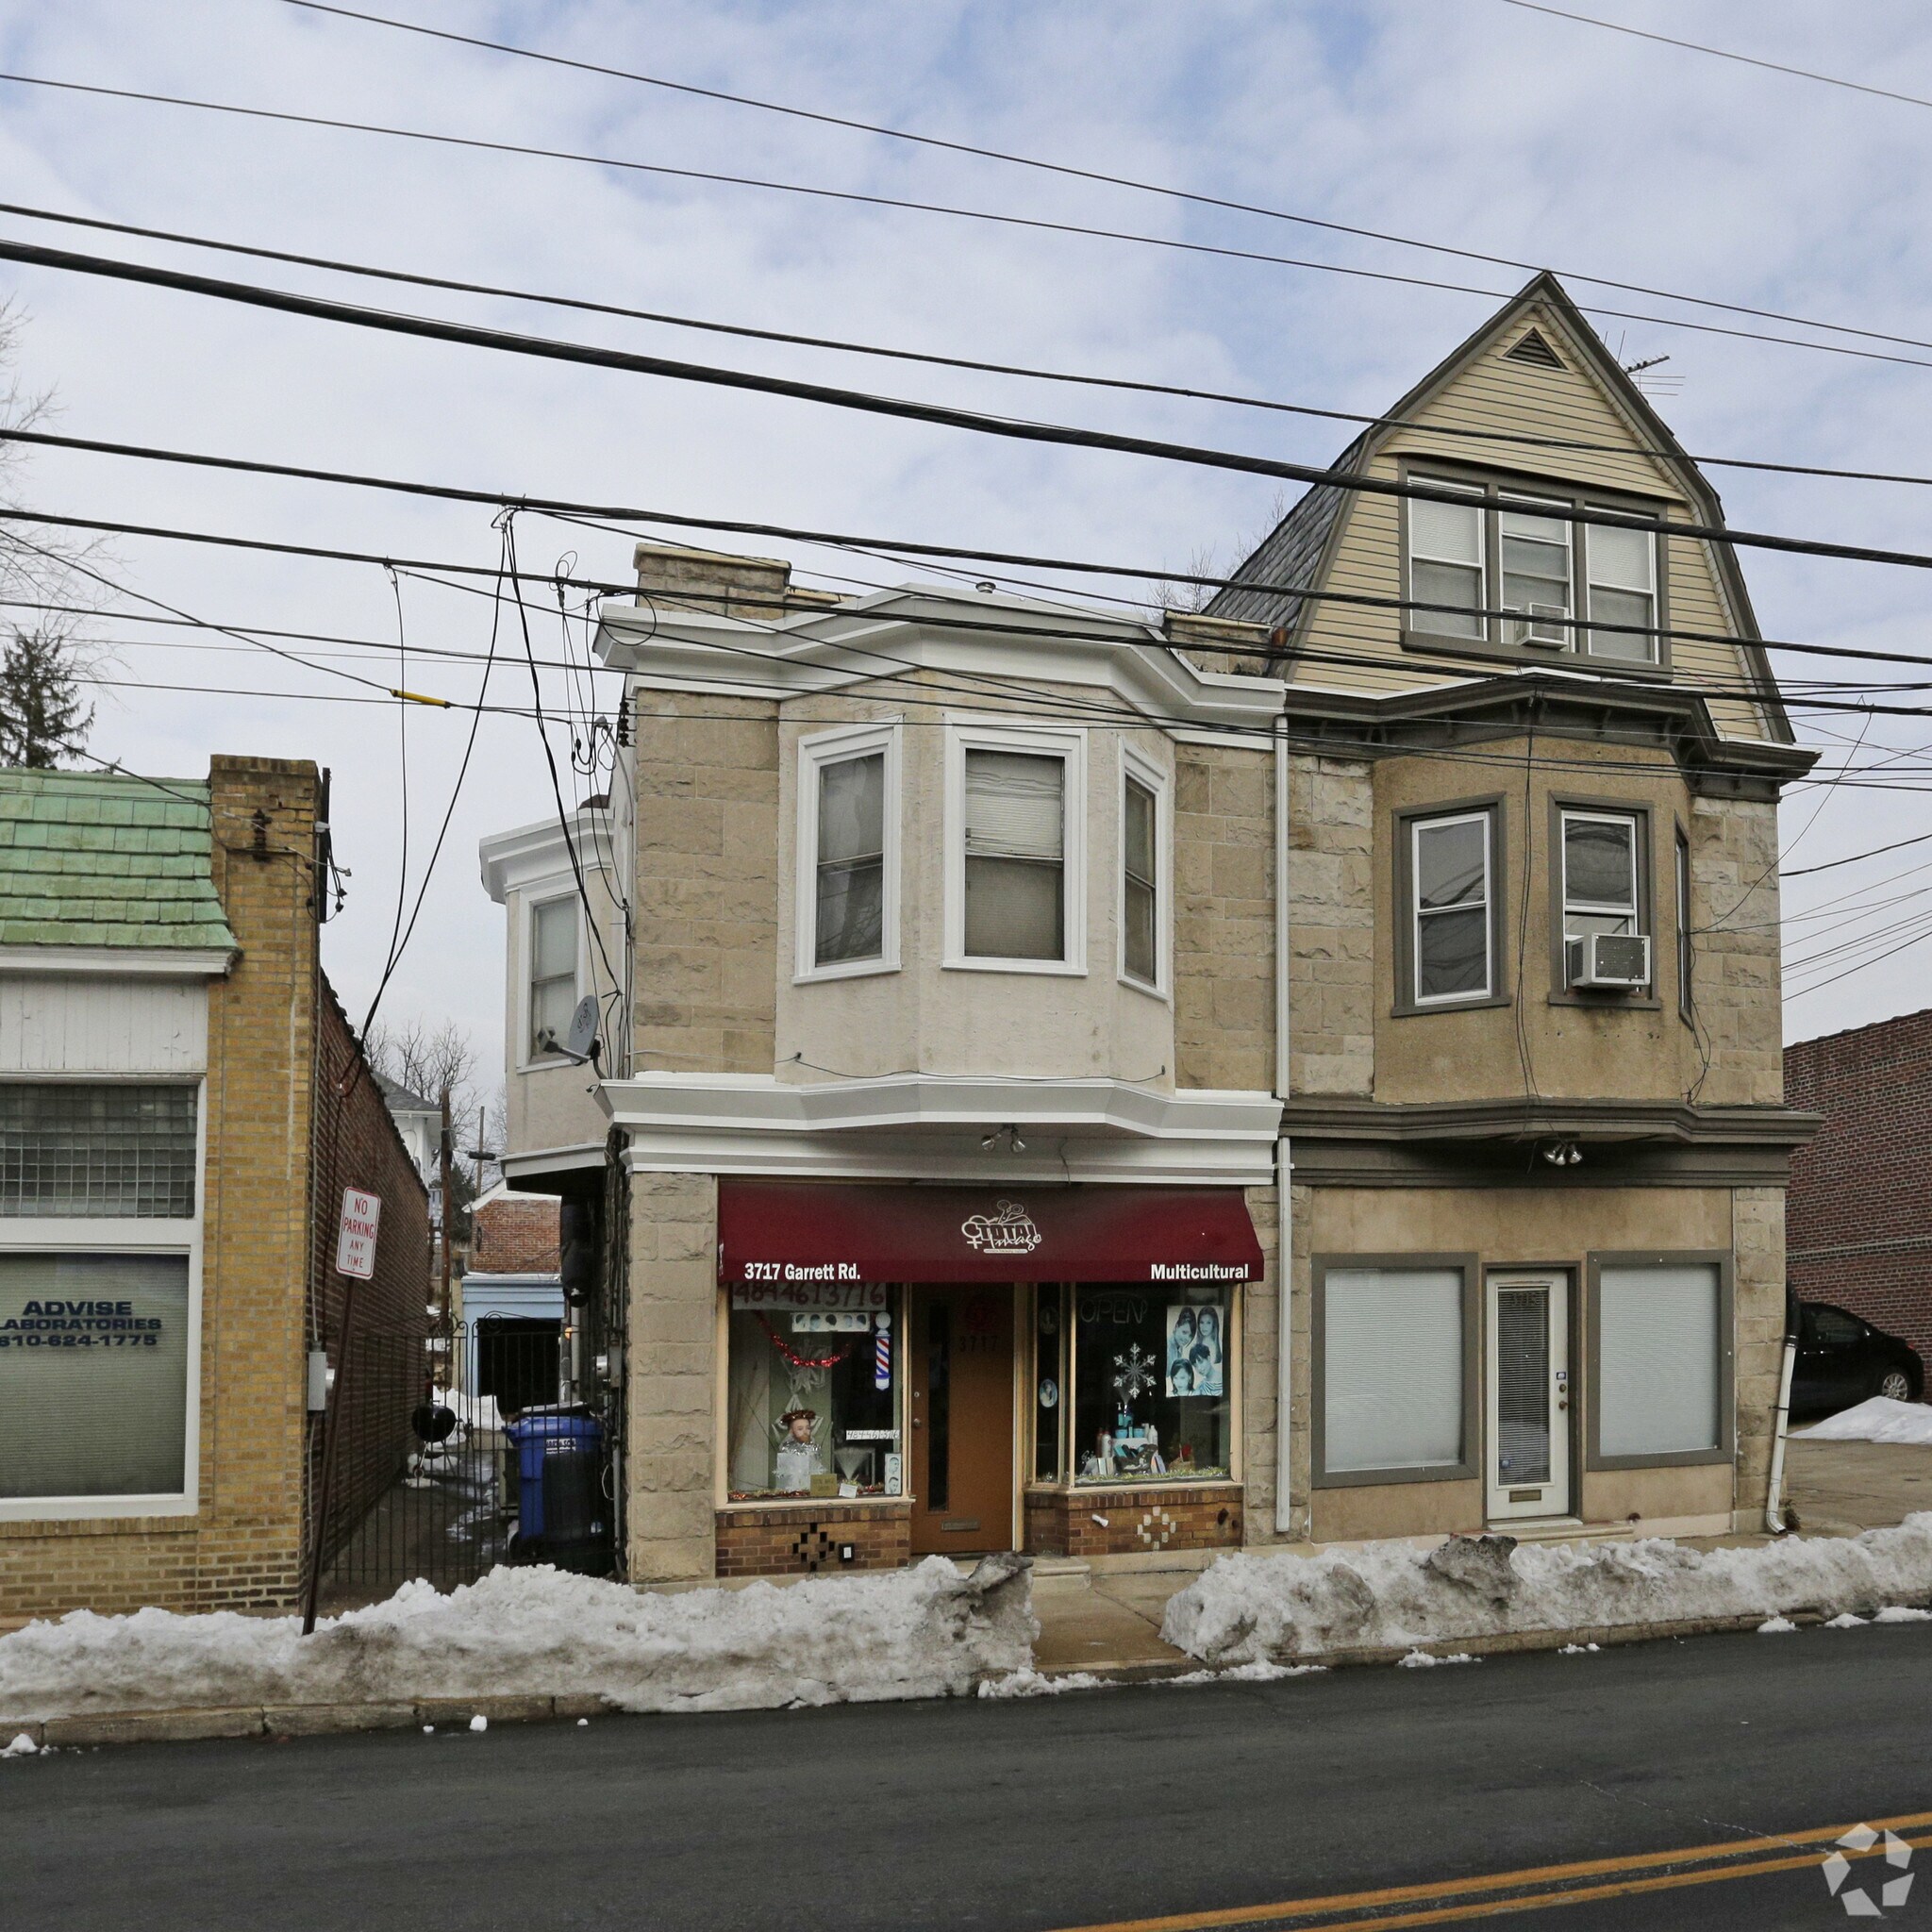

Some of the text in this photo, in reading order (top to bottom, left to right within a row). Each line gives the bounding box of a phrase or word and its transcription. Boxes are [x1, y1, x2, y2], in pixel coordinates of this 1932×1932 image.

[354, 1198, 368, 1215] NO
[342, 1217, 375, 1239] PARKING
[349, 1240, 364, 1252] ANY
[347, 1255, 364, 1268] TIME
[744, 1262, 861, 1280] 3717 Garrett Rd.
[1151, 1263, 1250, 1279] Multicultural
[22, 1301, 133, 1316] ADVISE
[1080, 1299, 1142, 1324] OPEN
[0, 1335, 158, 1347] 610-624-1775
